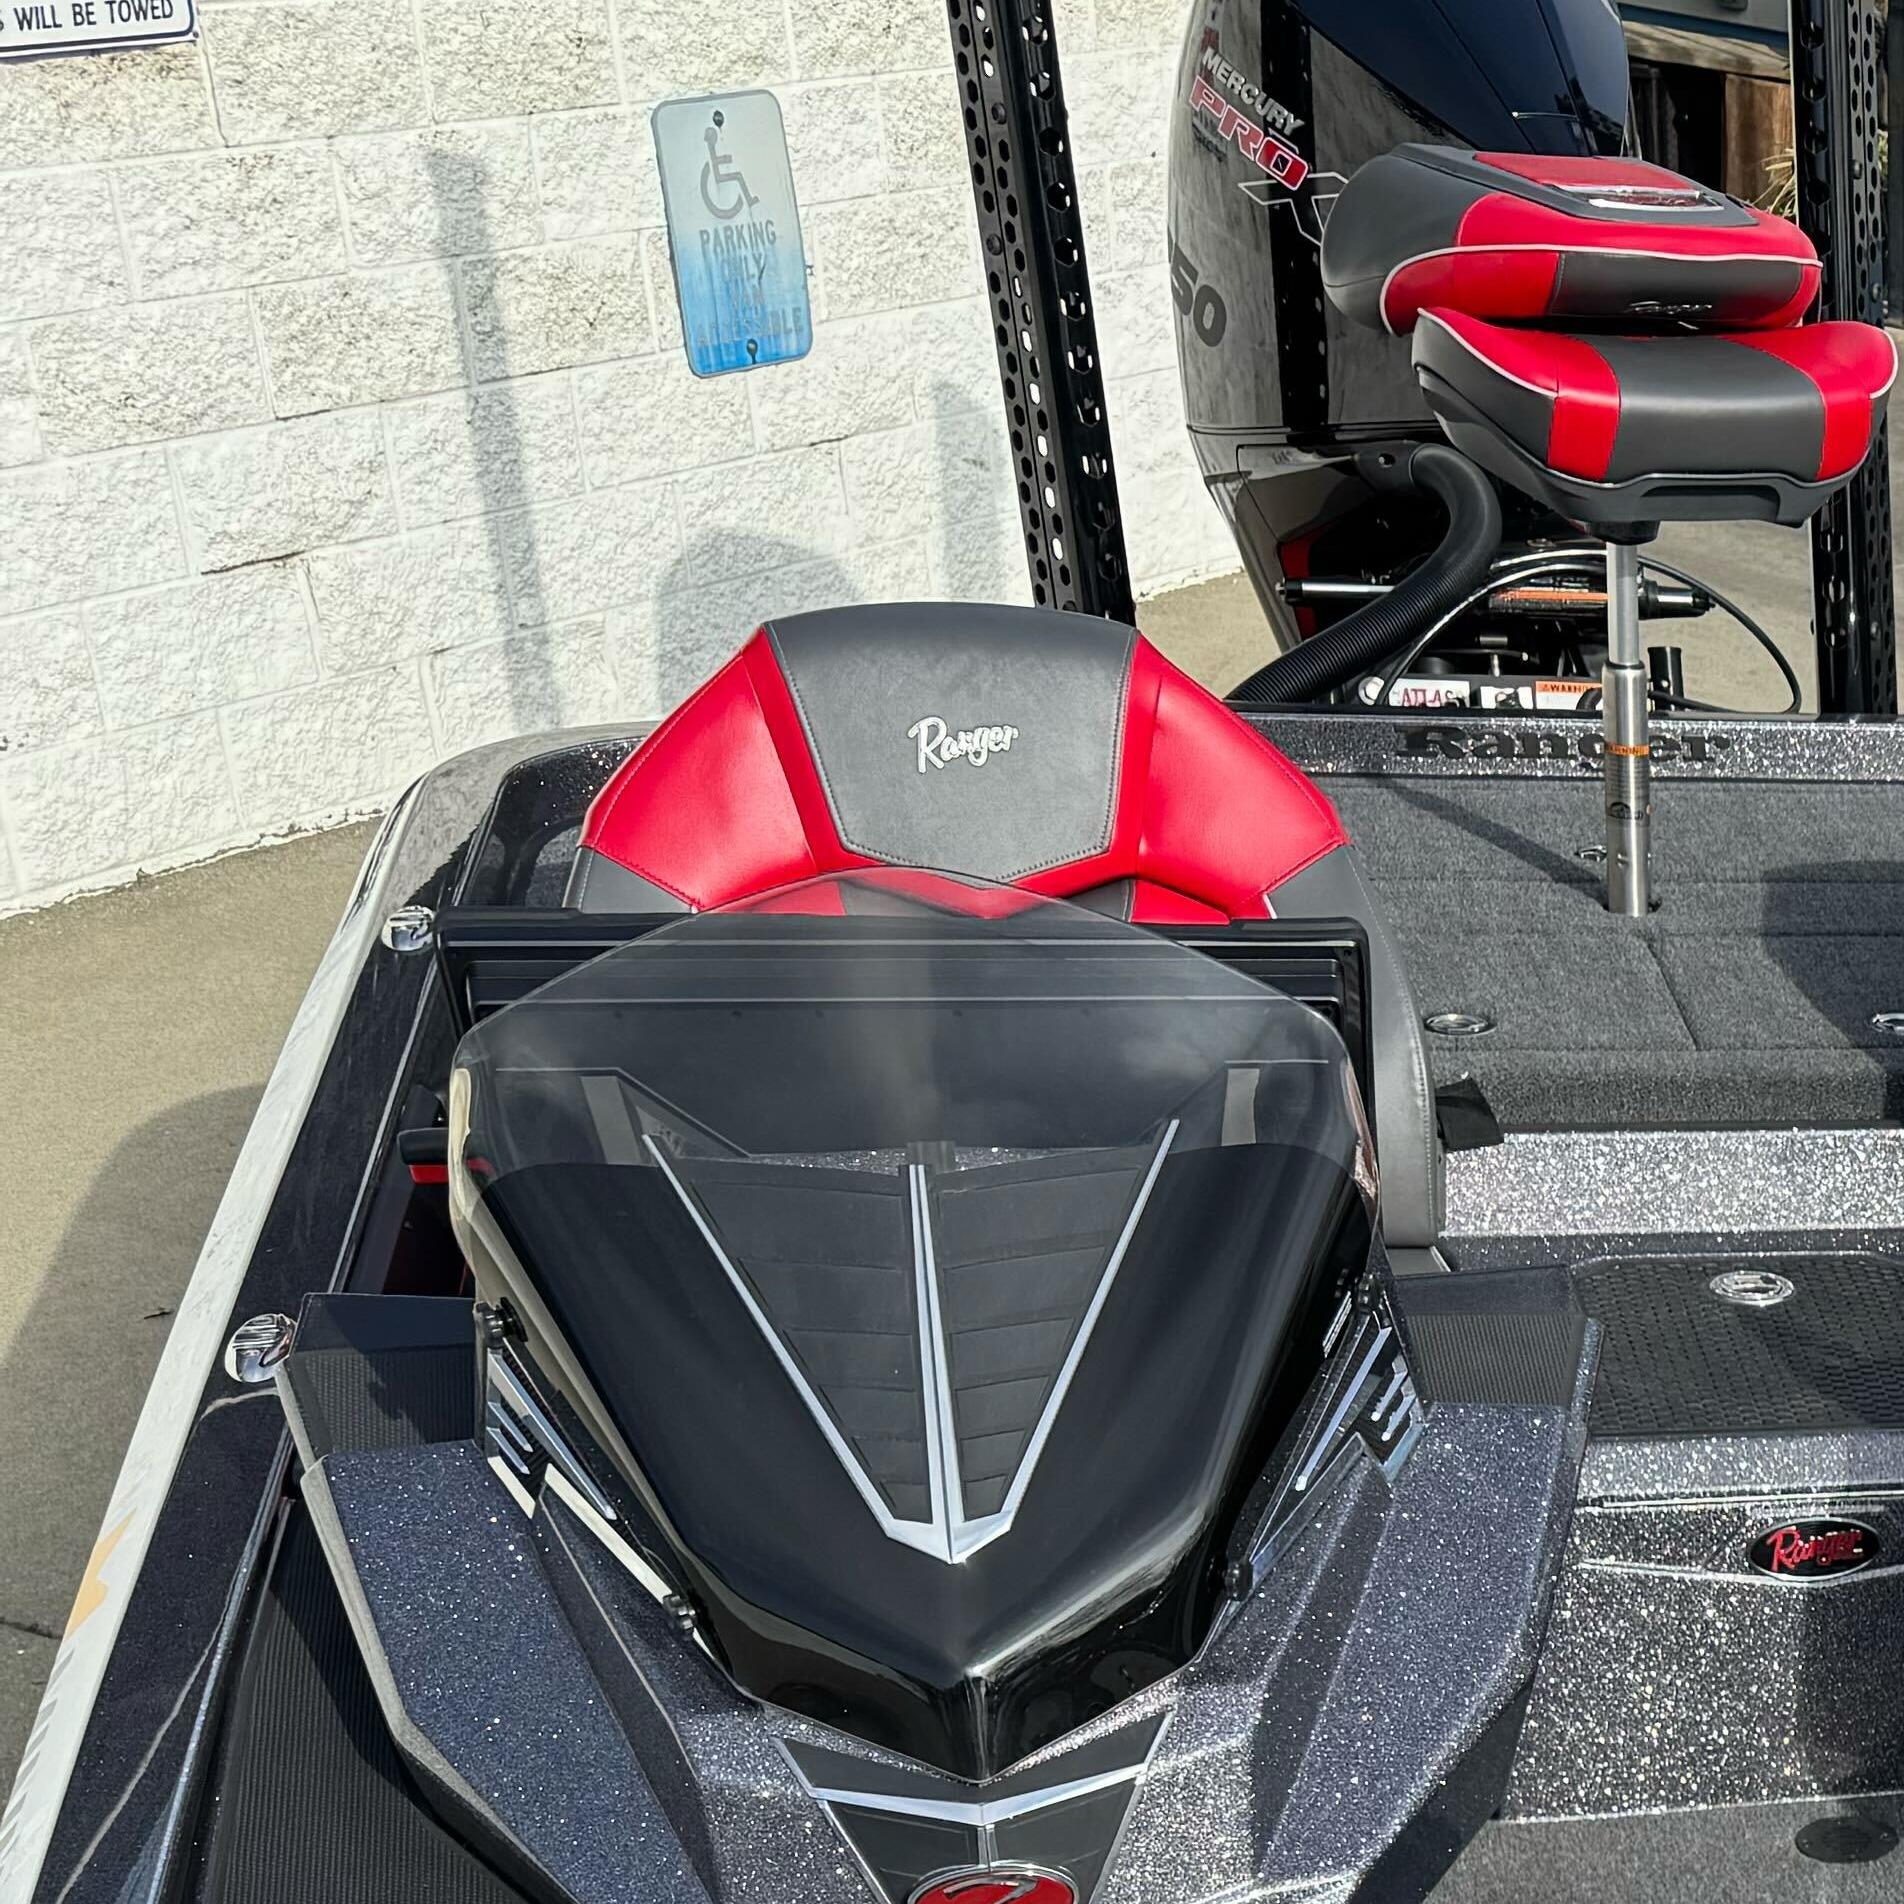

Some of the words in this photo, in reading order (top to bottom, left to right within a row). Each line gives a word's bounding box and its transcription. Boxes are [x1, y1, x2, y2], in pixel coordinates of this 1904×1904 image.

[13, 5, 63, 31] WILL
[71, 2, 97, 27] BE
[104, 0, 174, 24] TOWED
[1202, 49, 1305, 136] MERCURY
[1189, 75, 1309, 191] PRO
[699, 219, 777, 256] PARKING
[720, 252, 767, 283] ONLY
[1168, 226, 1228, 348] 50
[907, 715, 1020, 774] Ranger
